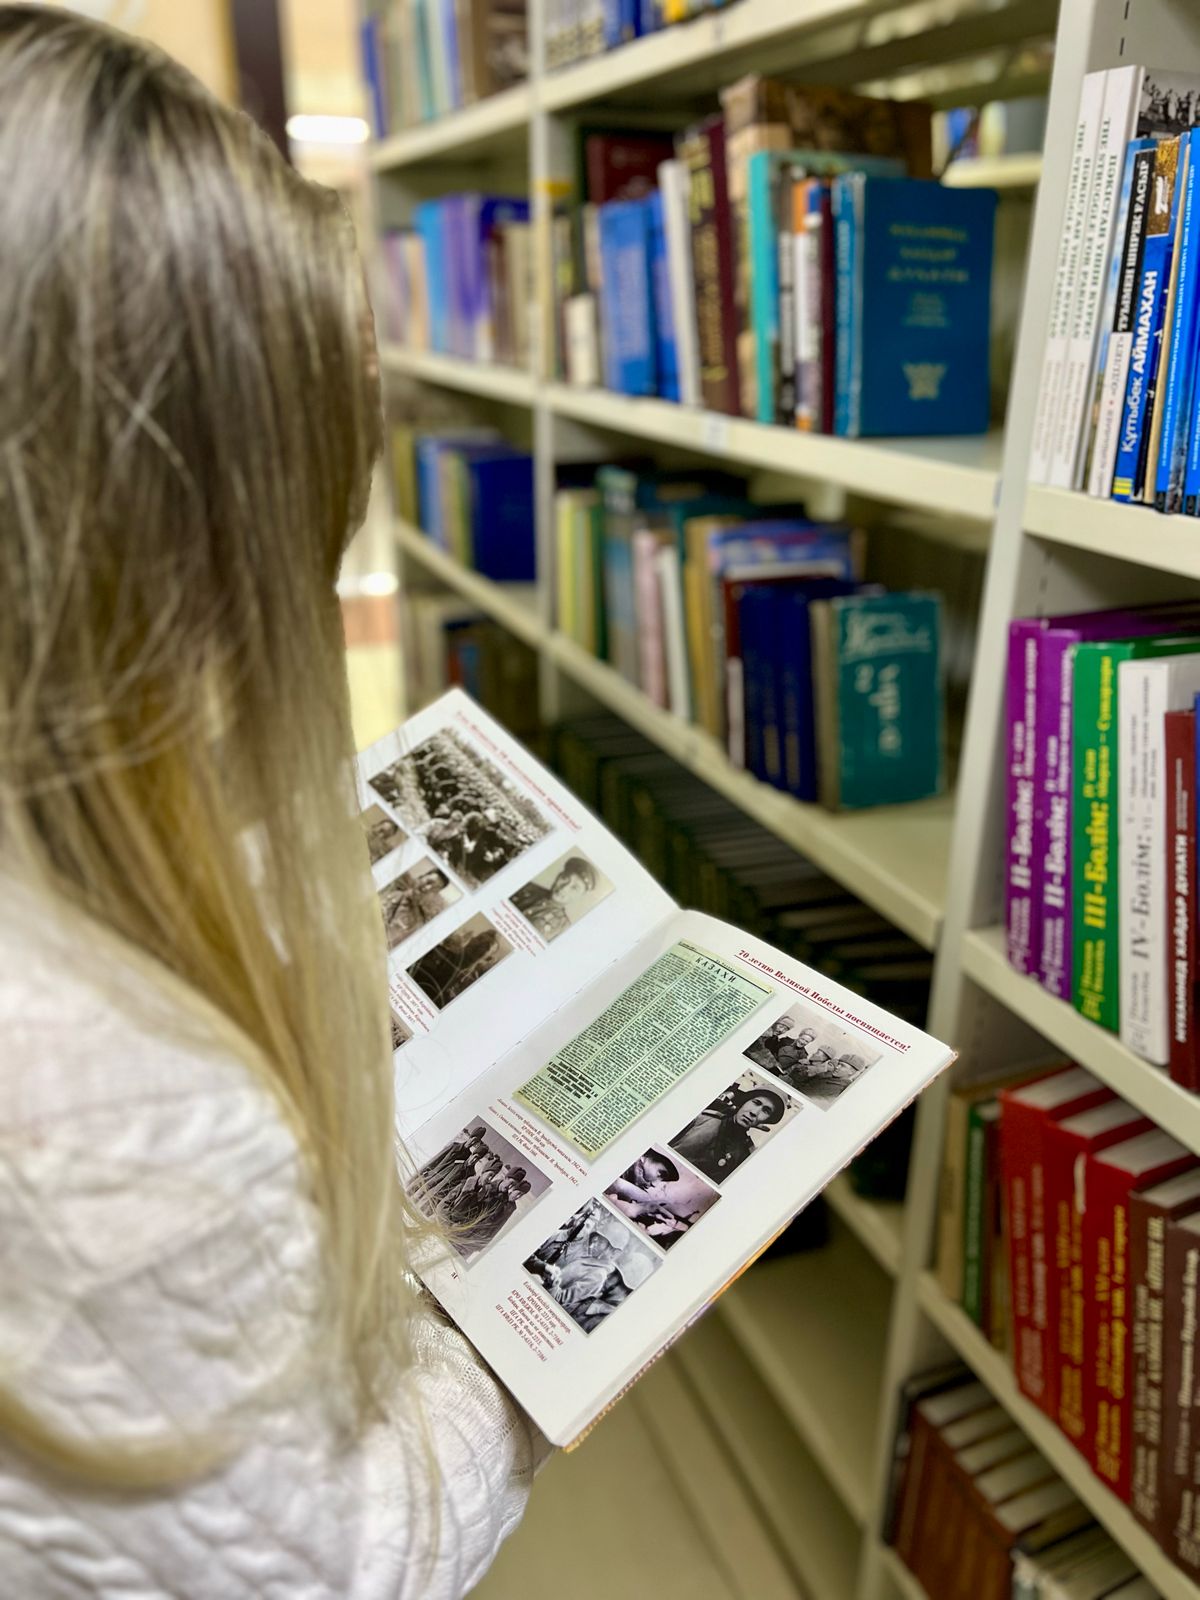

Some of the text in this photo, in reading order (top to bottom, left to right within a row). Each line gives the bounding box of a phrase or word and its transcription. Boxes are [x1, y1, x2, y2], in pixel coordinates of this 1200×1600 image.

[1100, 119, 1111, 148] THE
[1088, 153, 1105, 229] STRUGGLE
[1083, 236, 1093, 265] FOR
[1127, 215, 1141, 266] ШИРЕК
[1132, 271, 1156, 372] АЙМАХАН
[1175, 834, 1188, 894] ДУЛАТИ
[1174, 896, 1187, 956] ХАЙДАР
[738, 949, 749, 958] 70
[748, 957, 773, 972] летию
[774, 970, 809, 993] Великой
[810, 991, 844, 1014] Победы
[845, 1013, 910, 1050] посвящается!
